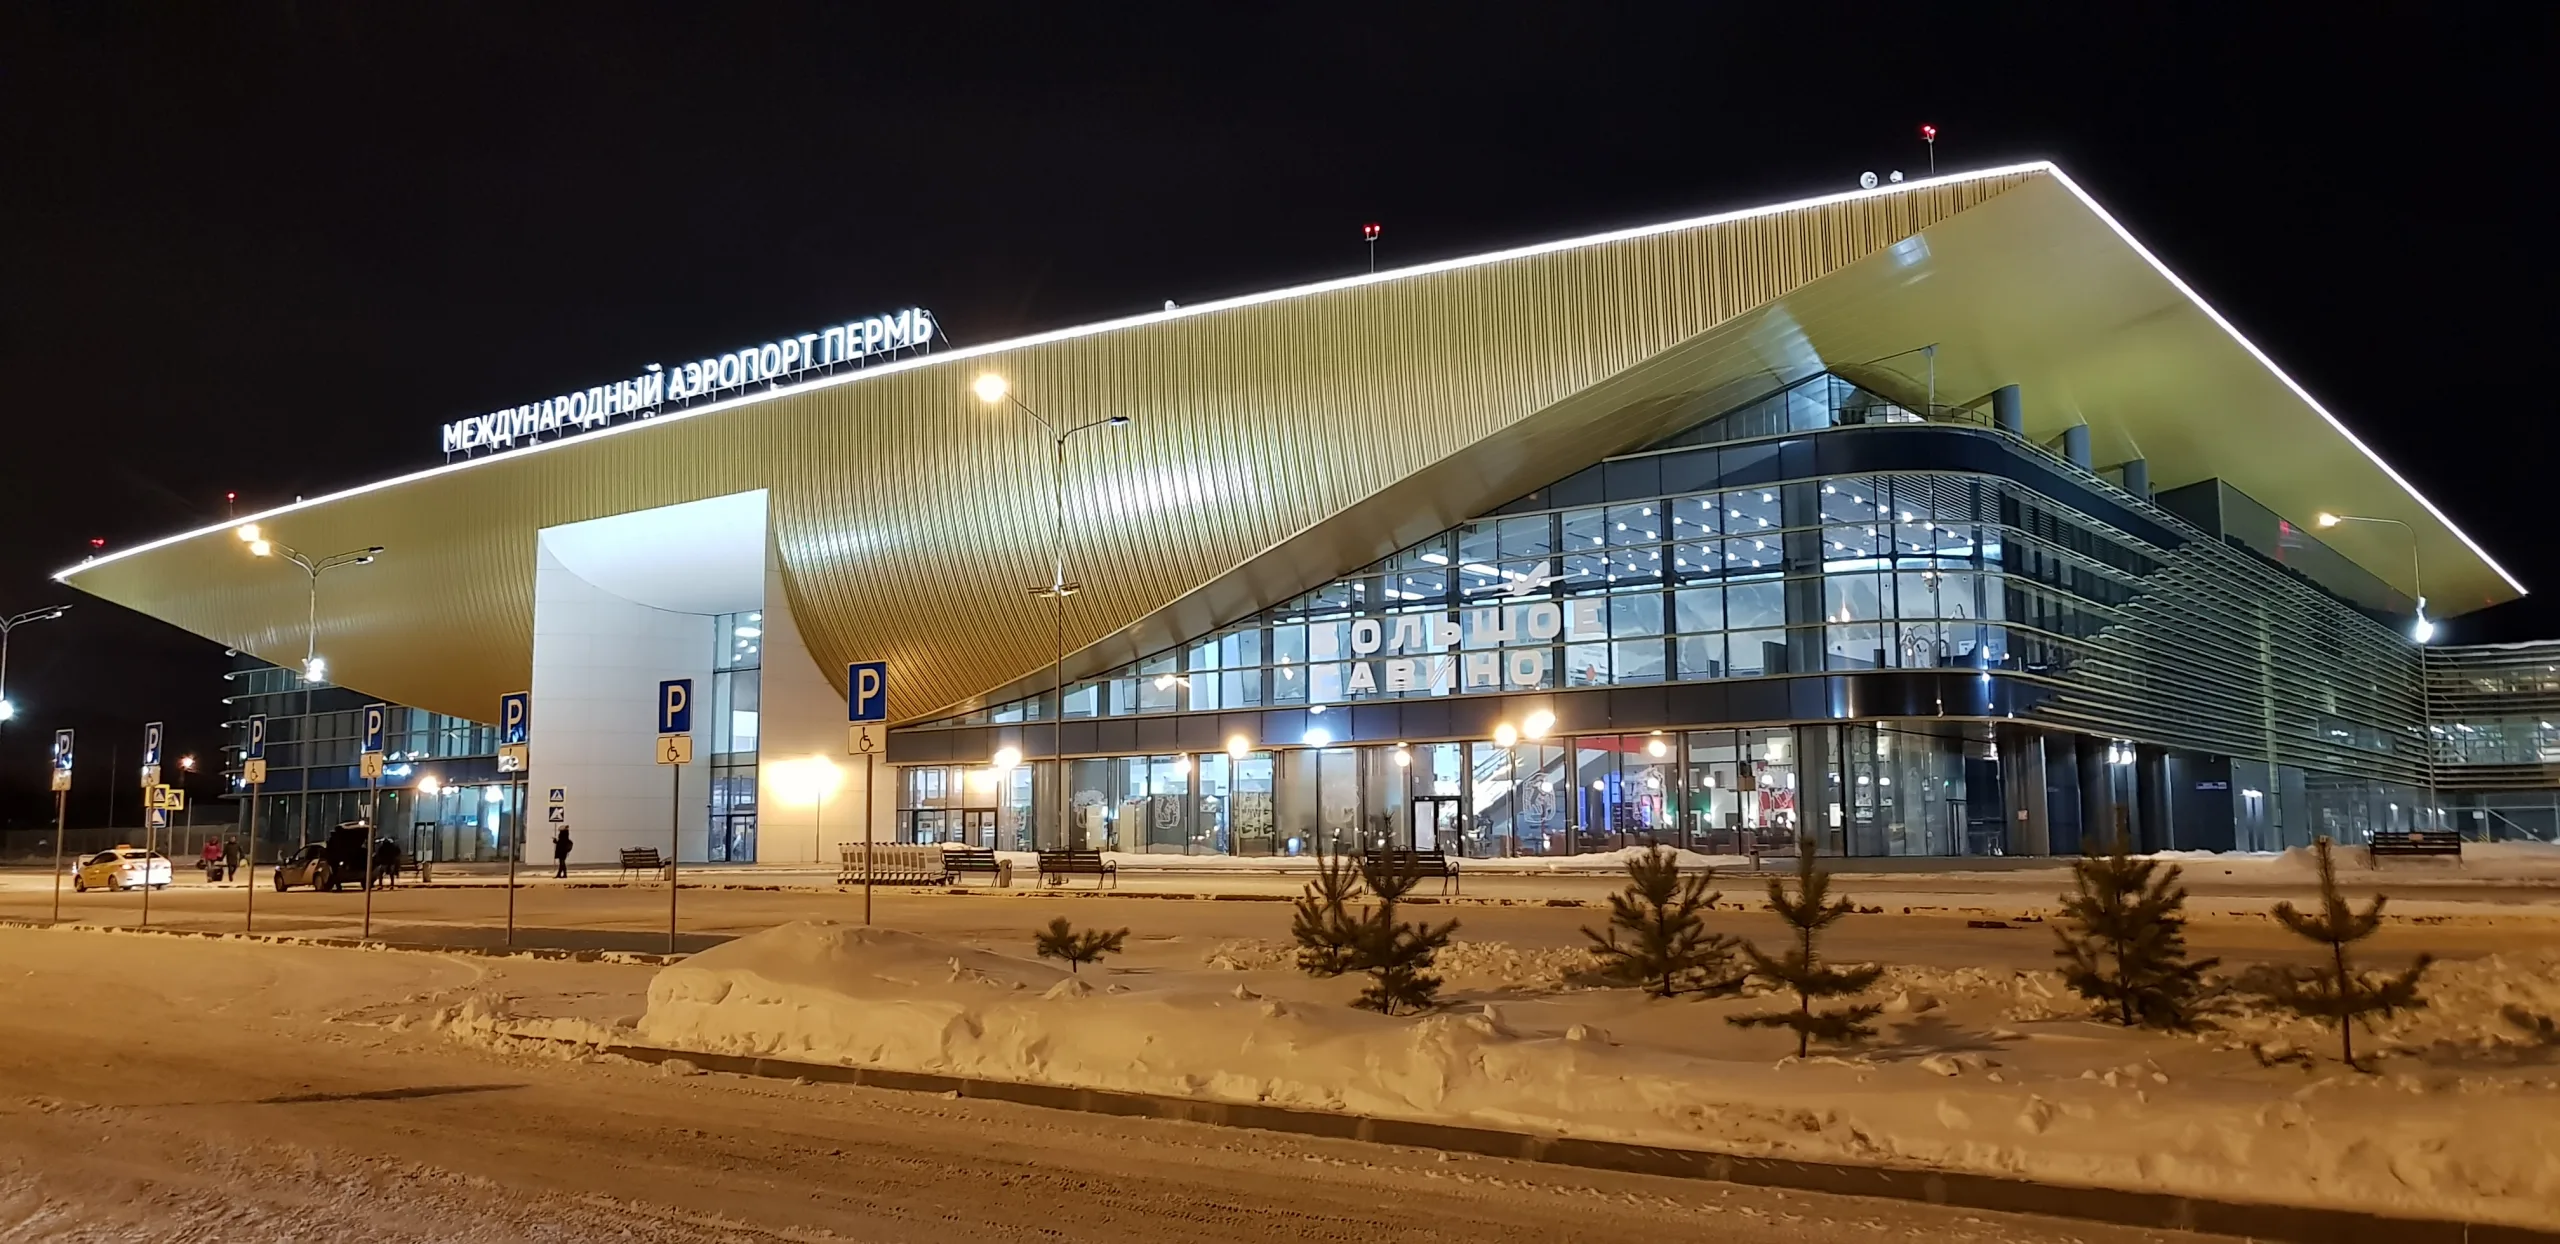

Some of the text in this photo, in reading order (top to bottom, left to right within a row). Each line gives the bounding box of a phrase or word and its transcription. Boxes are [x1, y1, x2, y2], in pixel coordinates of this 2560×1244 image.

[443, 307, 932, 451] МЕЖДУНАРОДНЫЙ АЭРОПОРТ ПЕРМЬ
[667, 684, 686, 728] P
[858, 668, 880, 715] P
[251, 720, 263, 755] P
[368, 710, 381, 747] P
[507, 698, 523, 742] P
